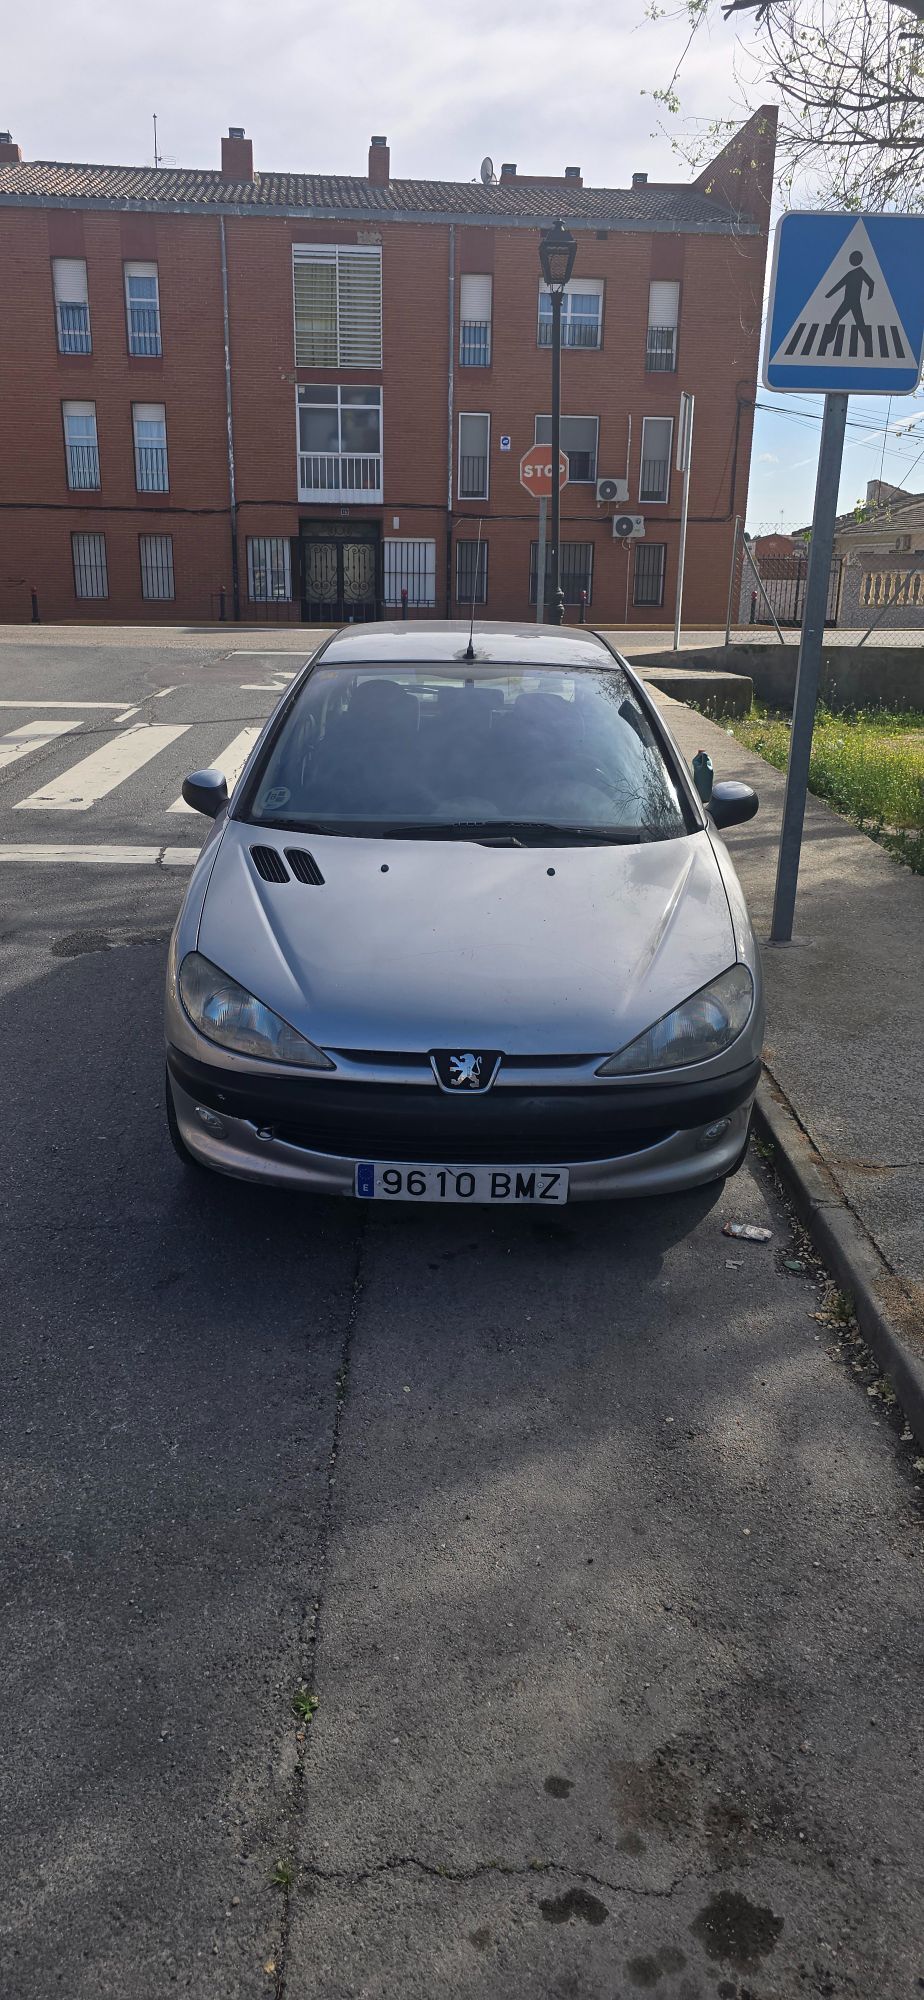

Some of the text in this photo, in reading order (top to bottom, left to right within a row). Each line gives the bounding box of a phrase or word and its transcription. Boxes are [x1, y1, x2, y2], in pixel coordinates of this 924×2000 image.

[363, 1184, 369, 1192] E
[382, 1169, 561, 1200] 9610 BMZ
